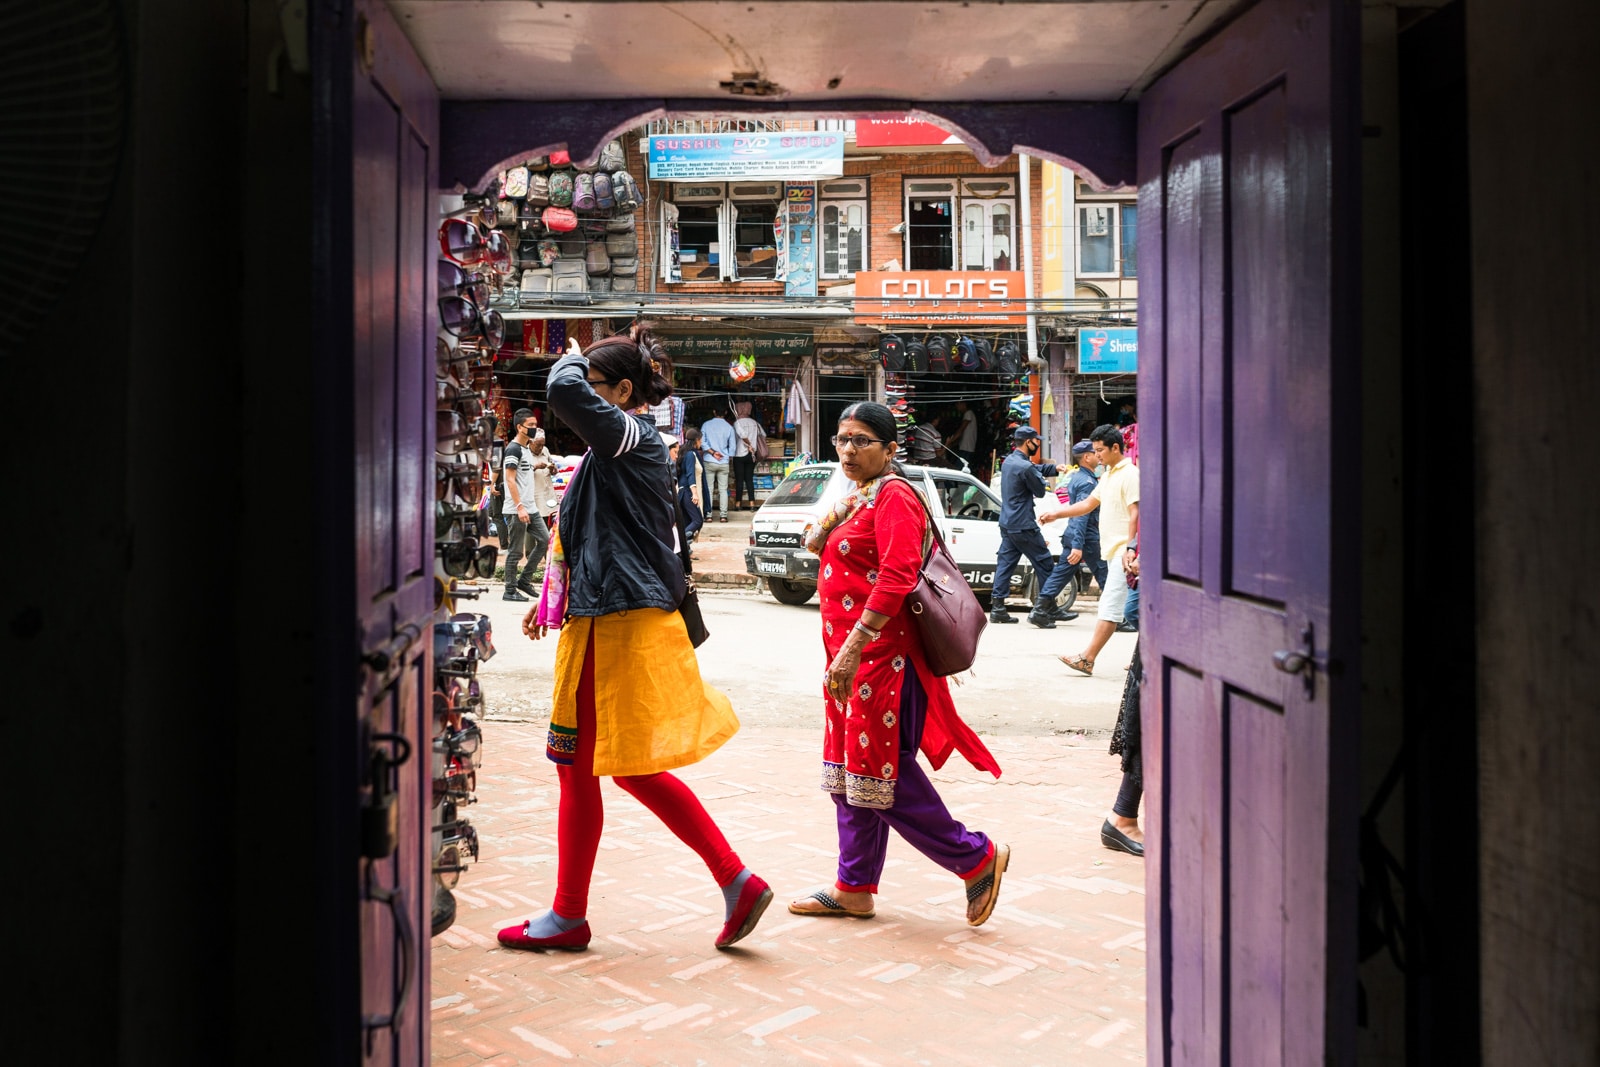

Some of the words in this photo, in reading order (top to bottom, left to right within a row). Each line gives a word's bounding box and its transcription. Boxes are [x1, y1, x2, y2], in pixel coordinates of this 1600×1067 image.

[656, 139, 721, 151] SUSHIL
[733, 137, 770, 149] DVD
[781, 136, 837, 148] SHOP
[787, 188, 814, 198] DVD
[789, 204, 812, 213] SHOP
[1110, 339, 1138, 353] Shres
[757, 534, 800, 544] Sports
